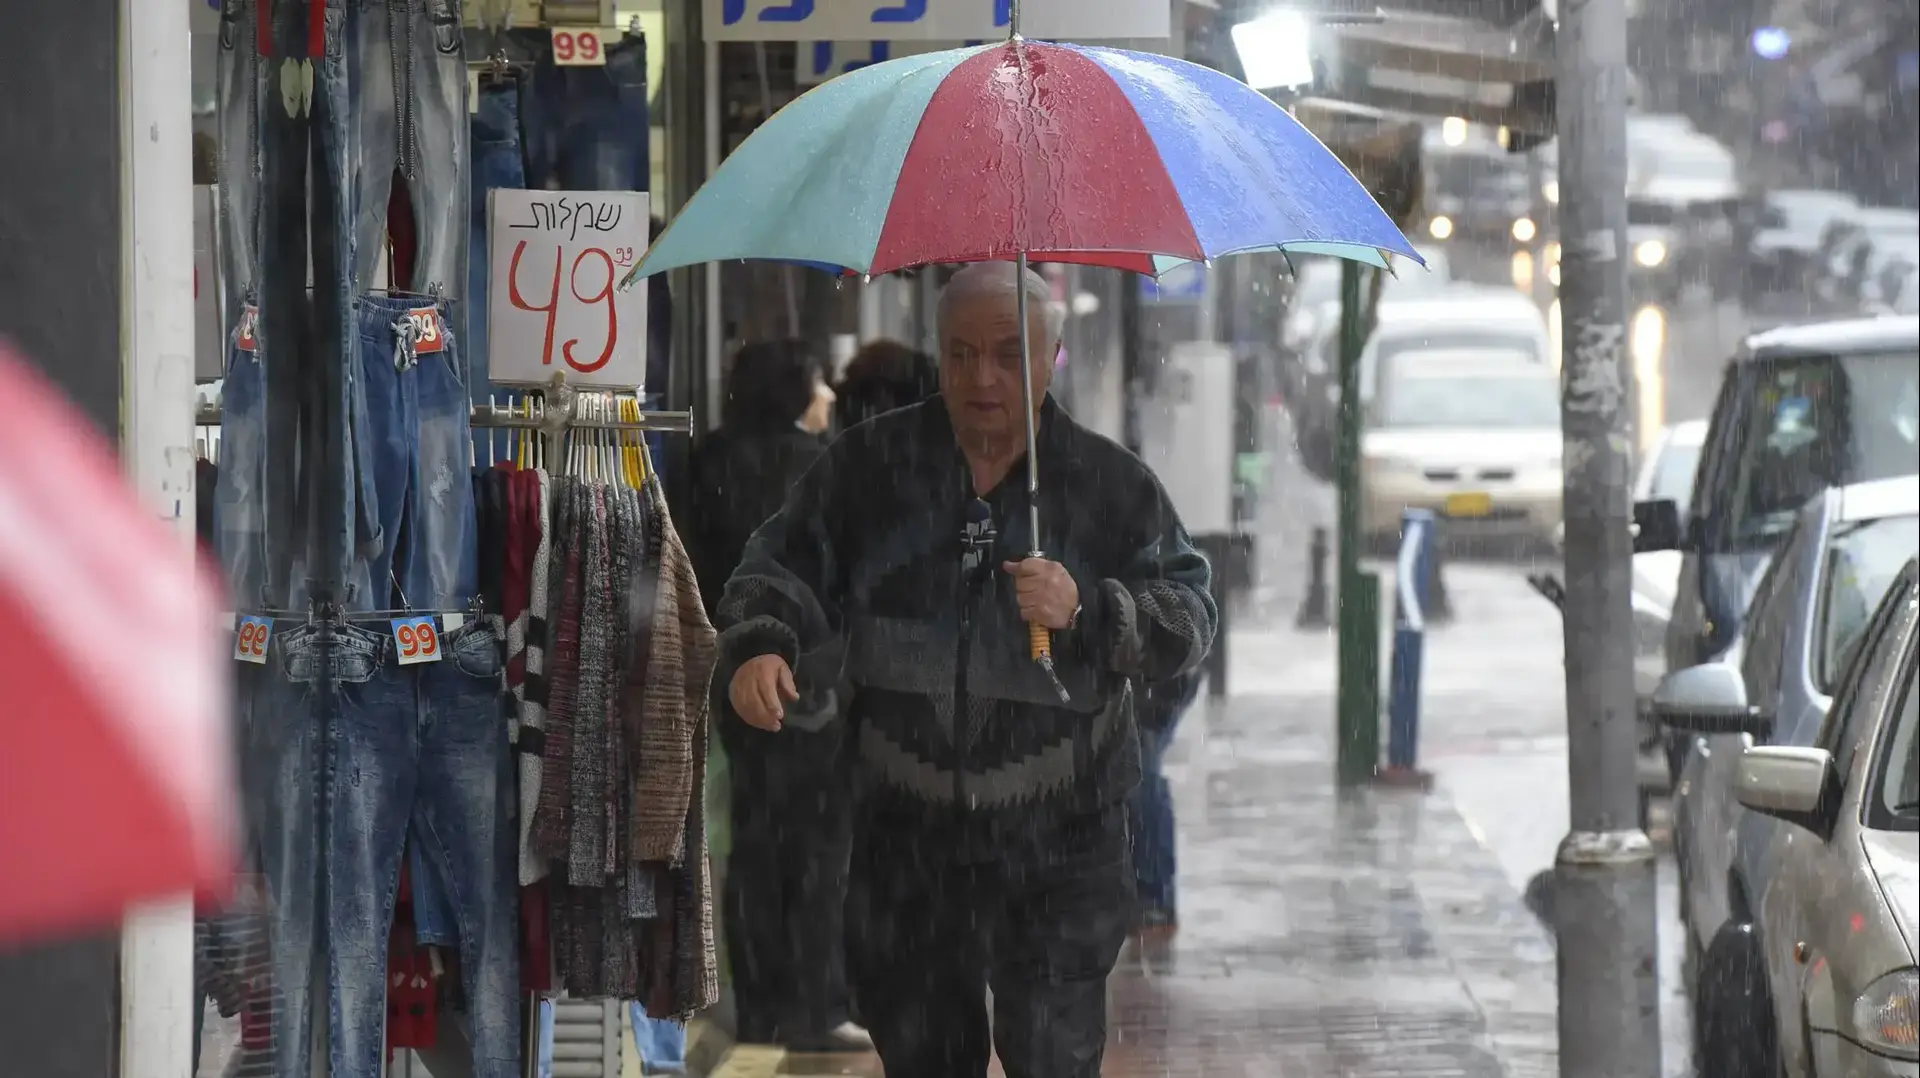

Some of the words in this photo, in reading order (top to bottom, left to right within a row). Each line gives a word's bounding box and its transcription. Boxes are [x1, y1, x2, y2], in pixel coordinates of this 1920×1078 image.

[554, 32, 599, 60] 99
[509, 197, 622, 241] שמלות
[397, 623, 437, 657] 99
